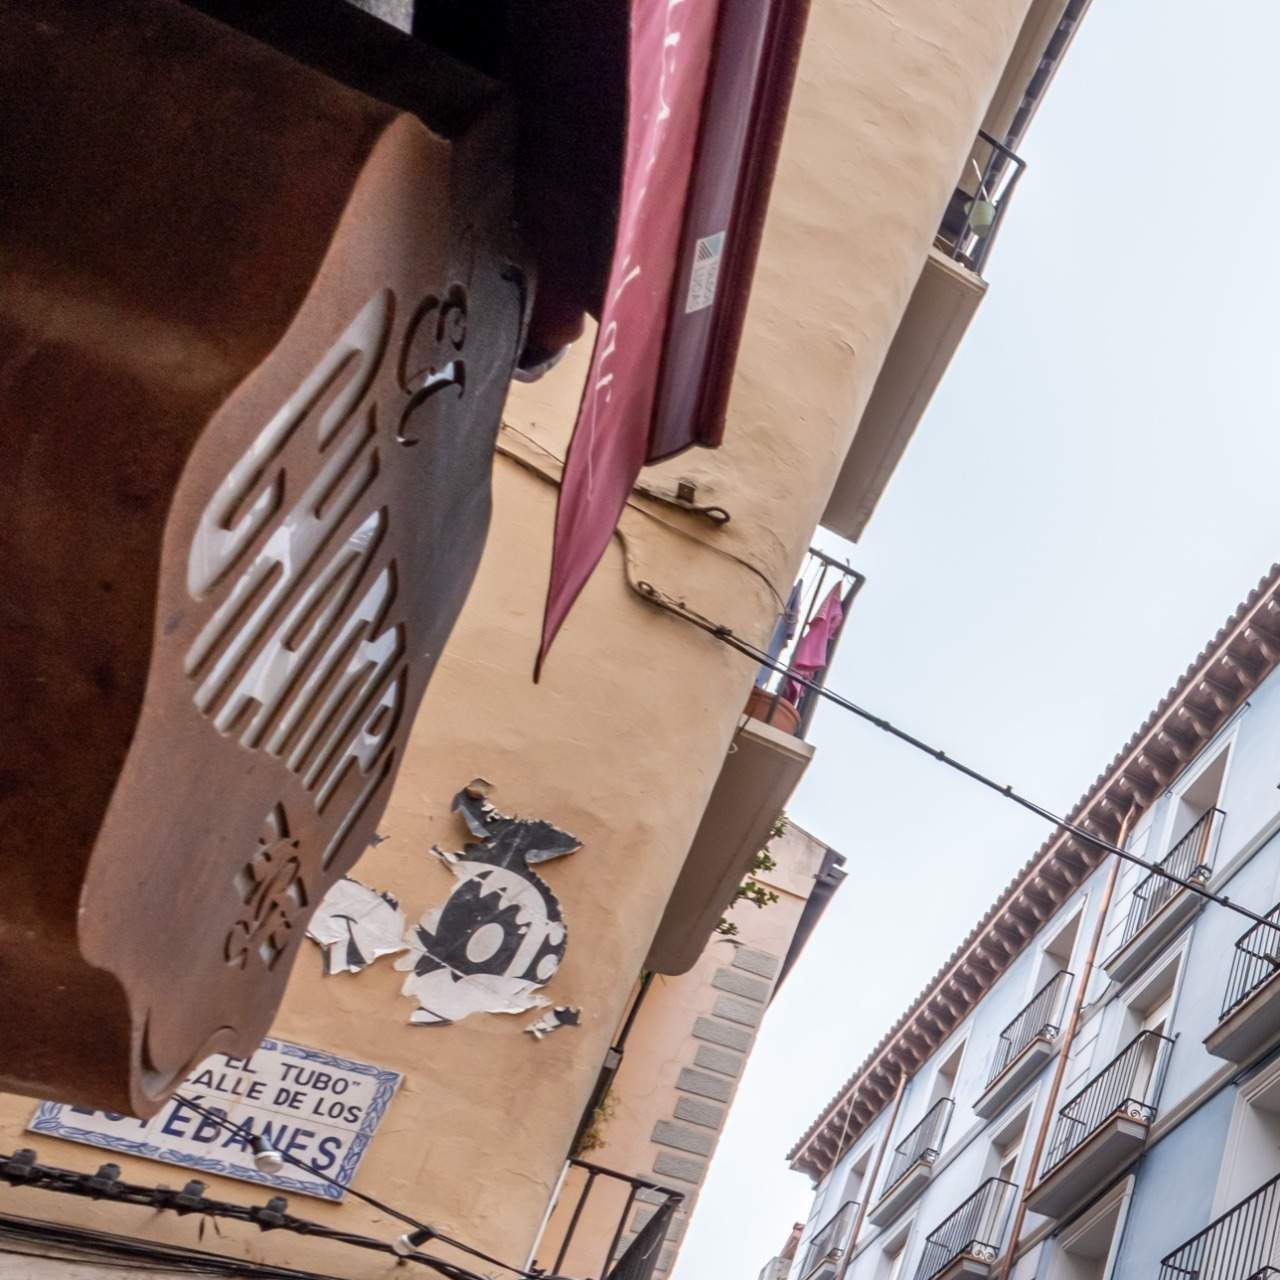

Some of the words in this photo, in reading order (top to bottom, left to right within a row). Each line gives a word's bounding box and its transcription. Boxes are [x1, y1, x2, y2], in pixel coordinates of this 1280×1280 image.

[186, 286, 408, 873] CHAMPI
[70, 1094, 343, 1172] ÉBANES
[183, 1068, 268, 1101] ALLE
[273, 1086, 304, 1111] DE
[312, 1100, 364, 1124] LOS
